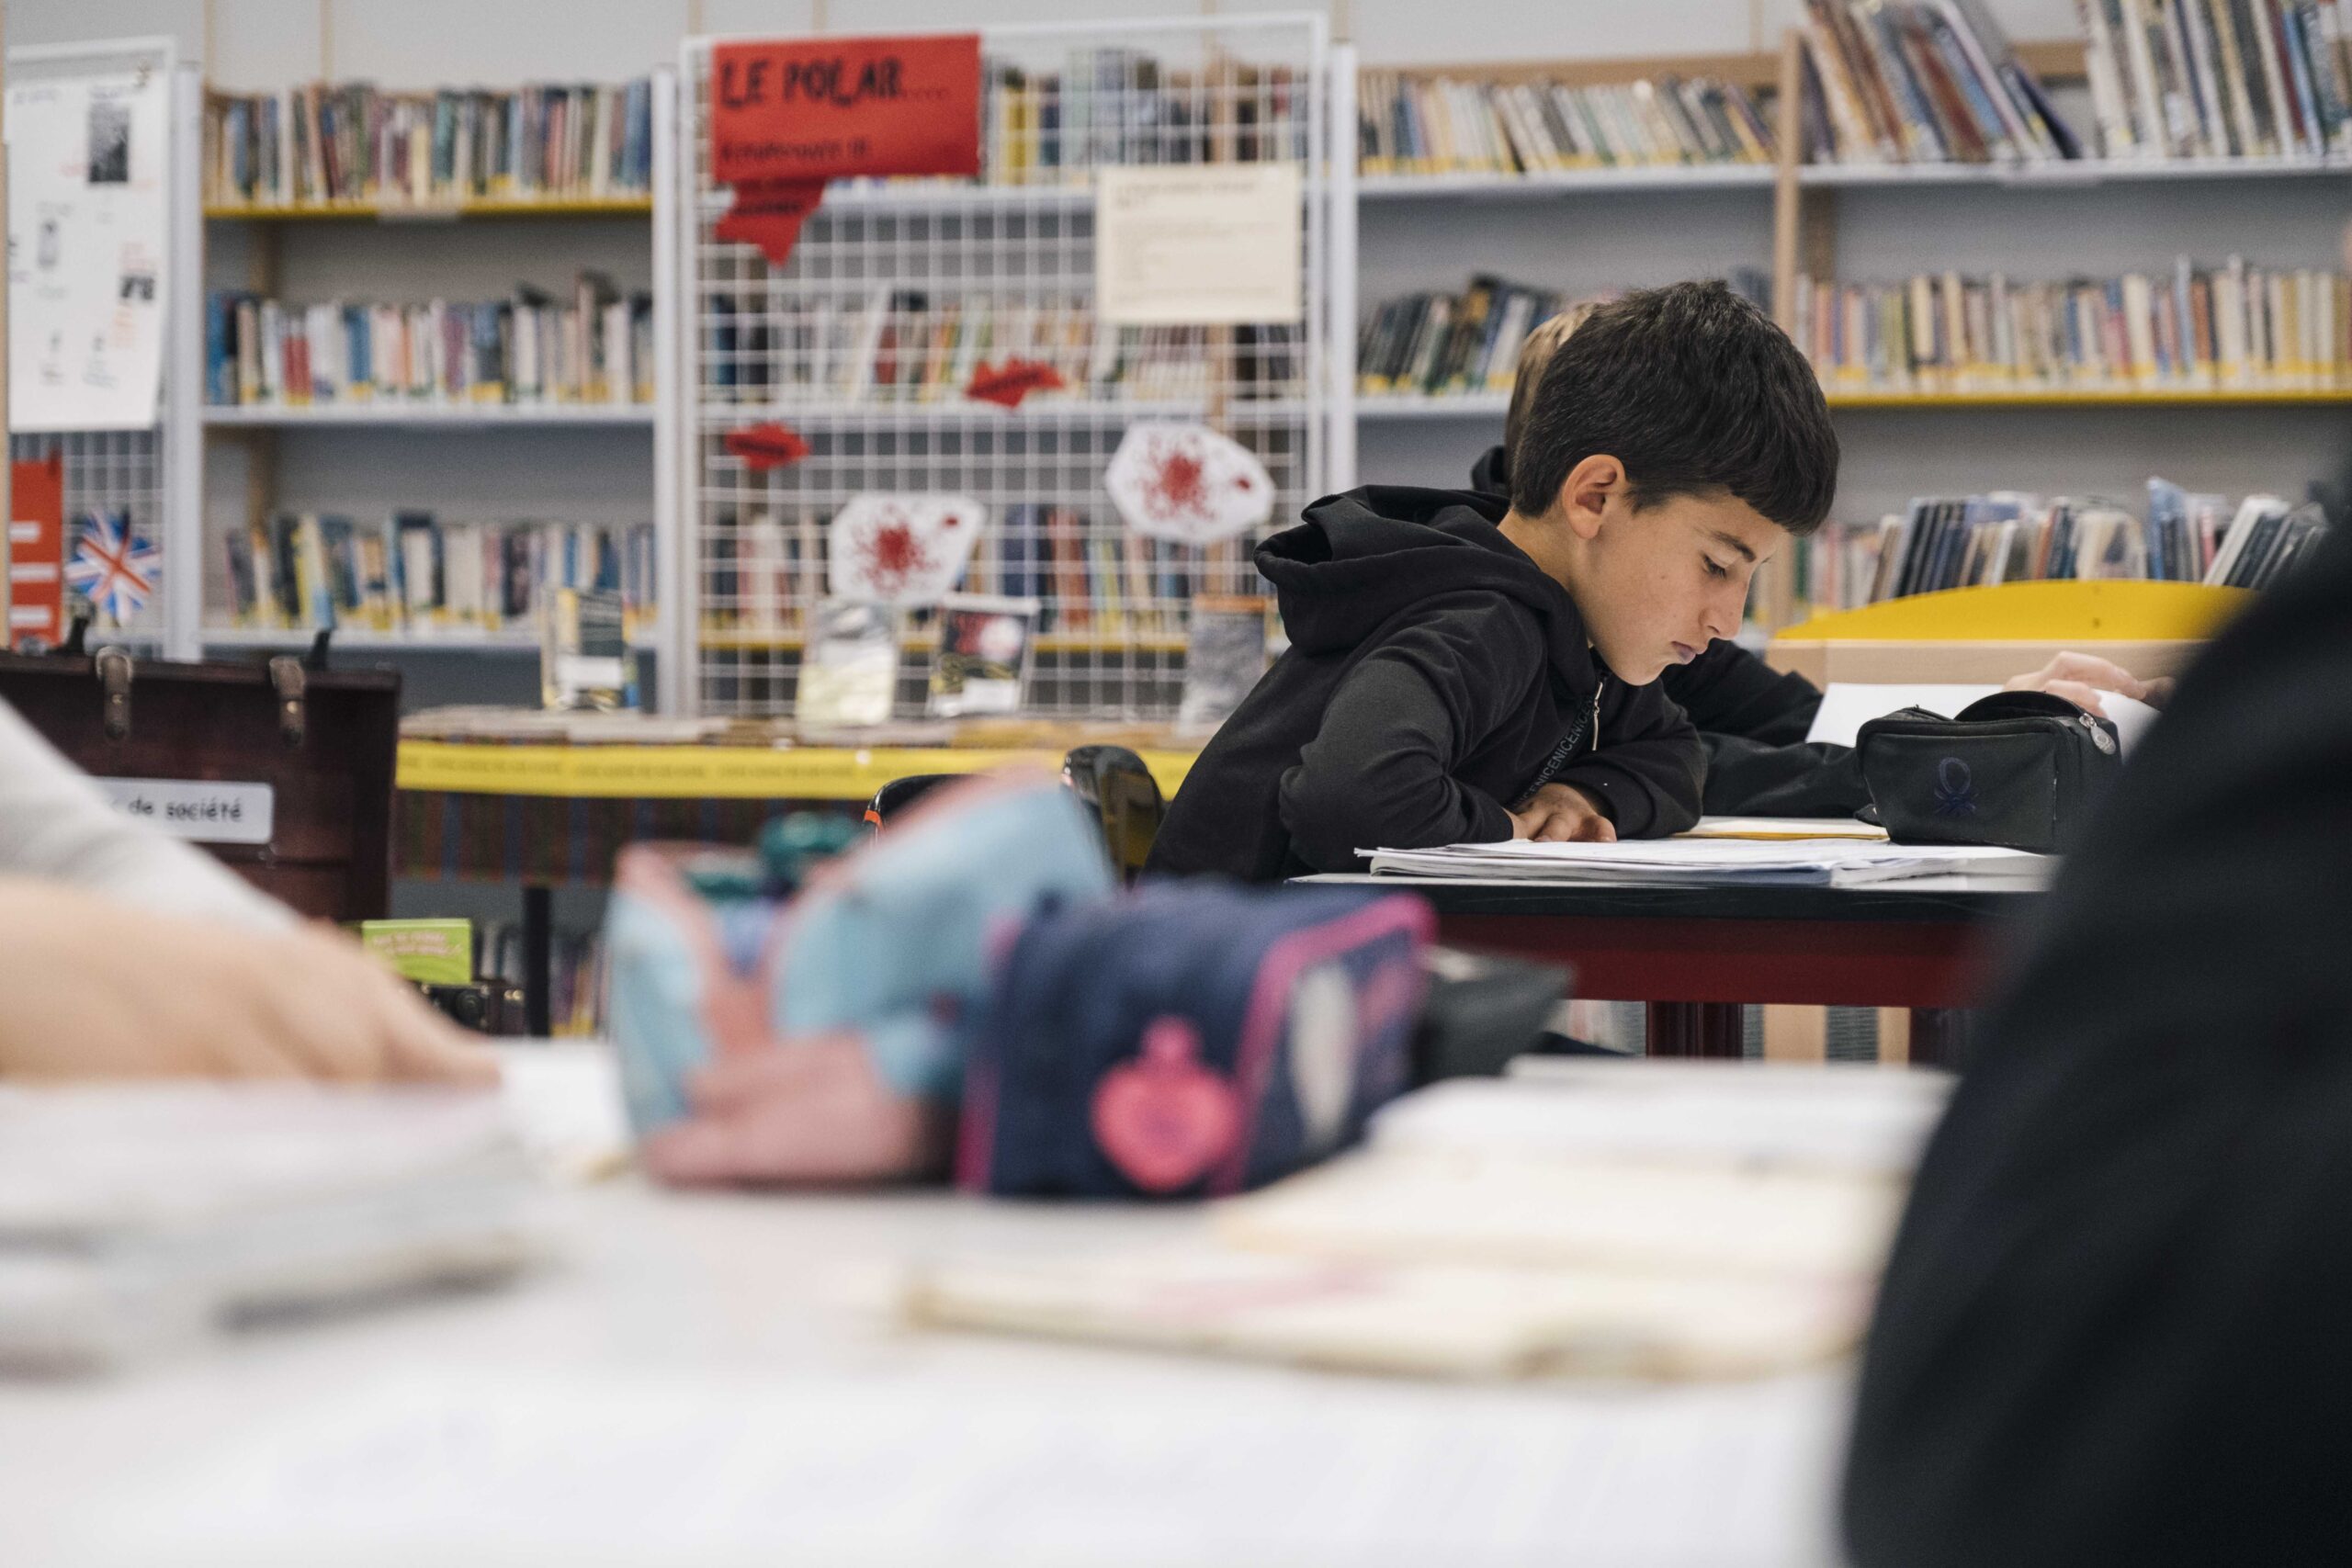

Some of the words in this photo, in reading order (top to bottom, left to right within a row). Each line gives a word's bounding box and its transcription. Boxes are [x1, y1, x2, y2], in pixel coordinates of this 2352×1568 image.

[721, 61, 769, 108] LE
[128, 796, 154, 816] de
[165, 796, 243, 822] société
